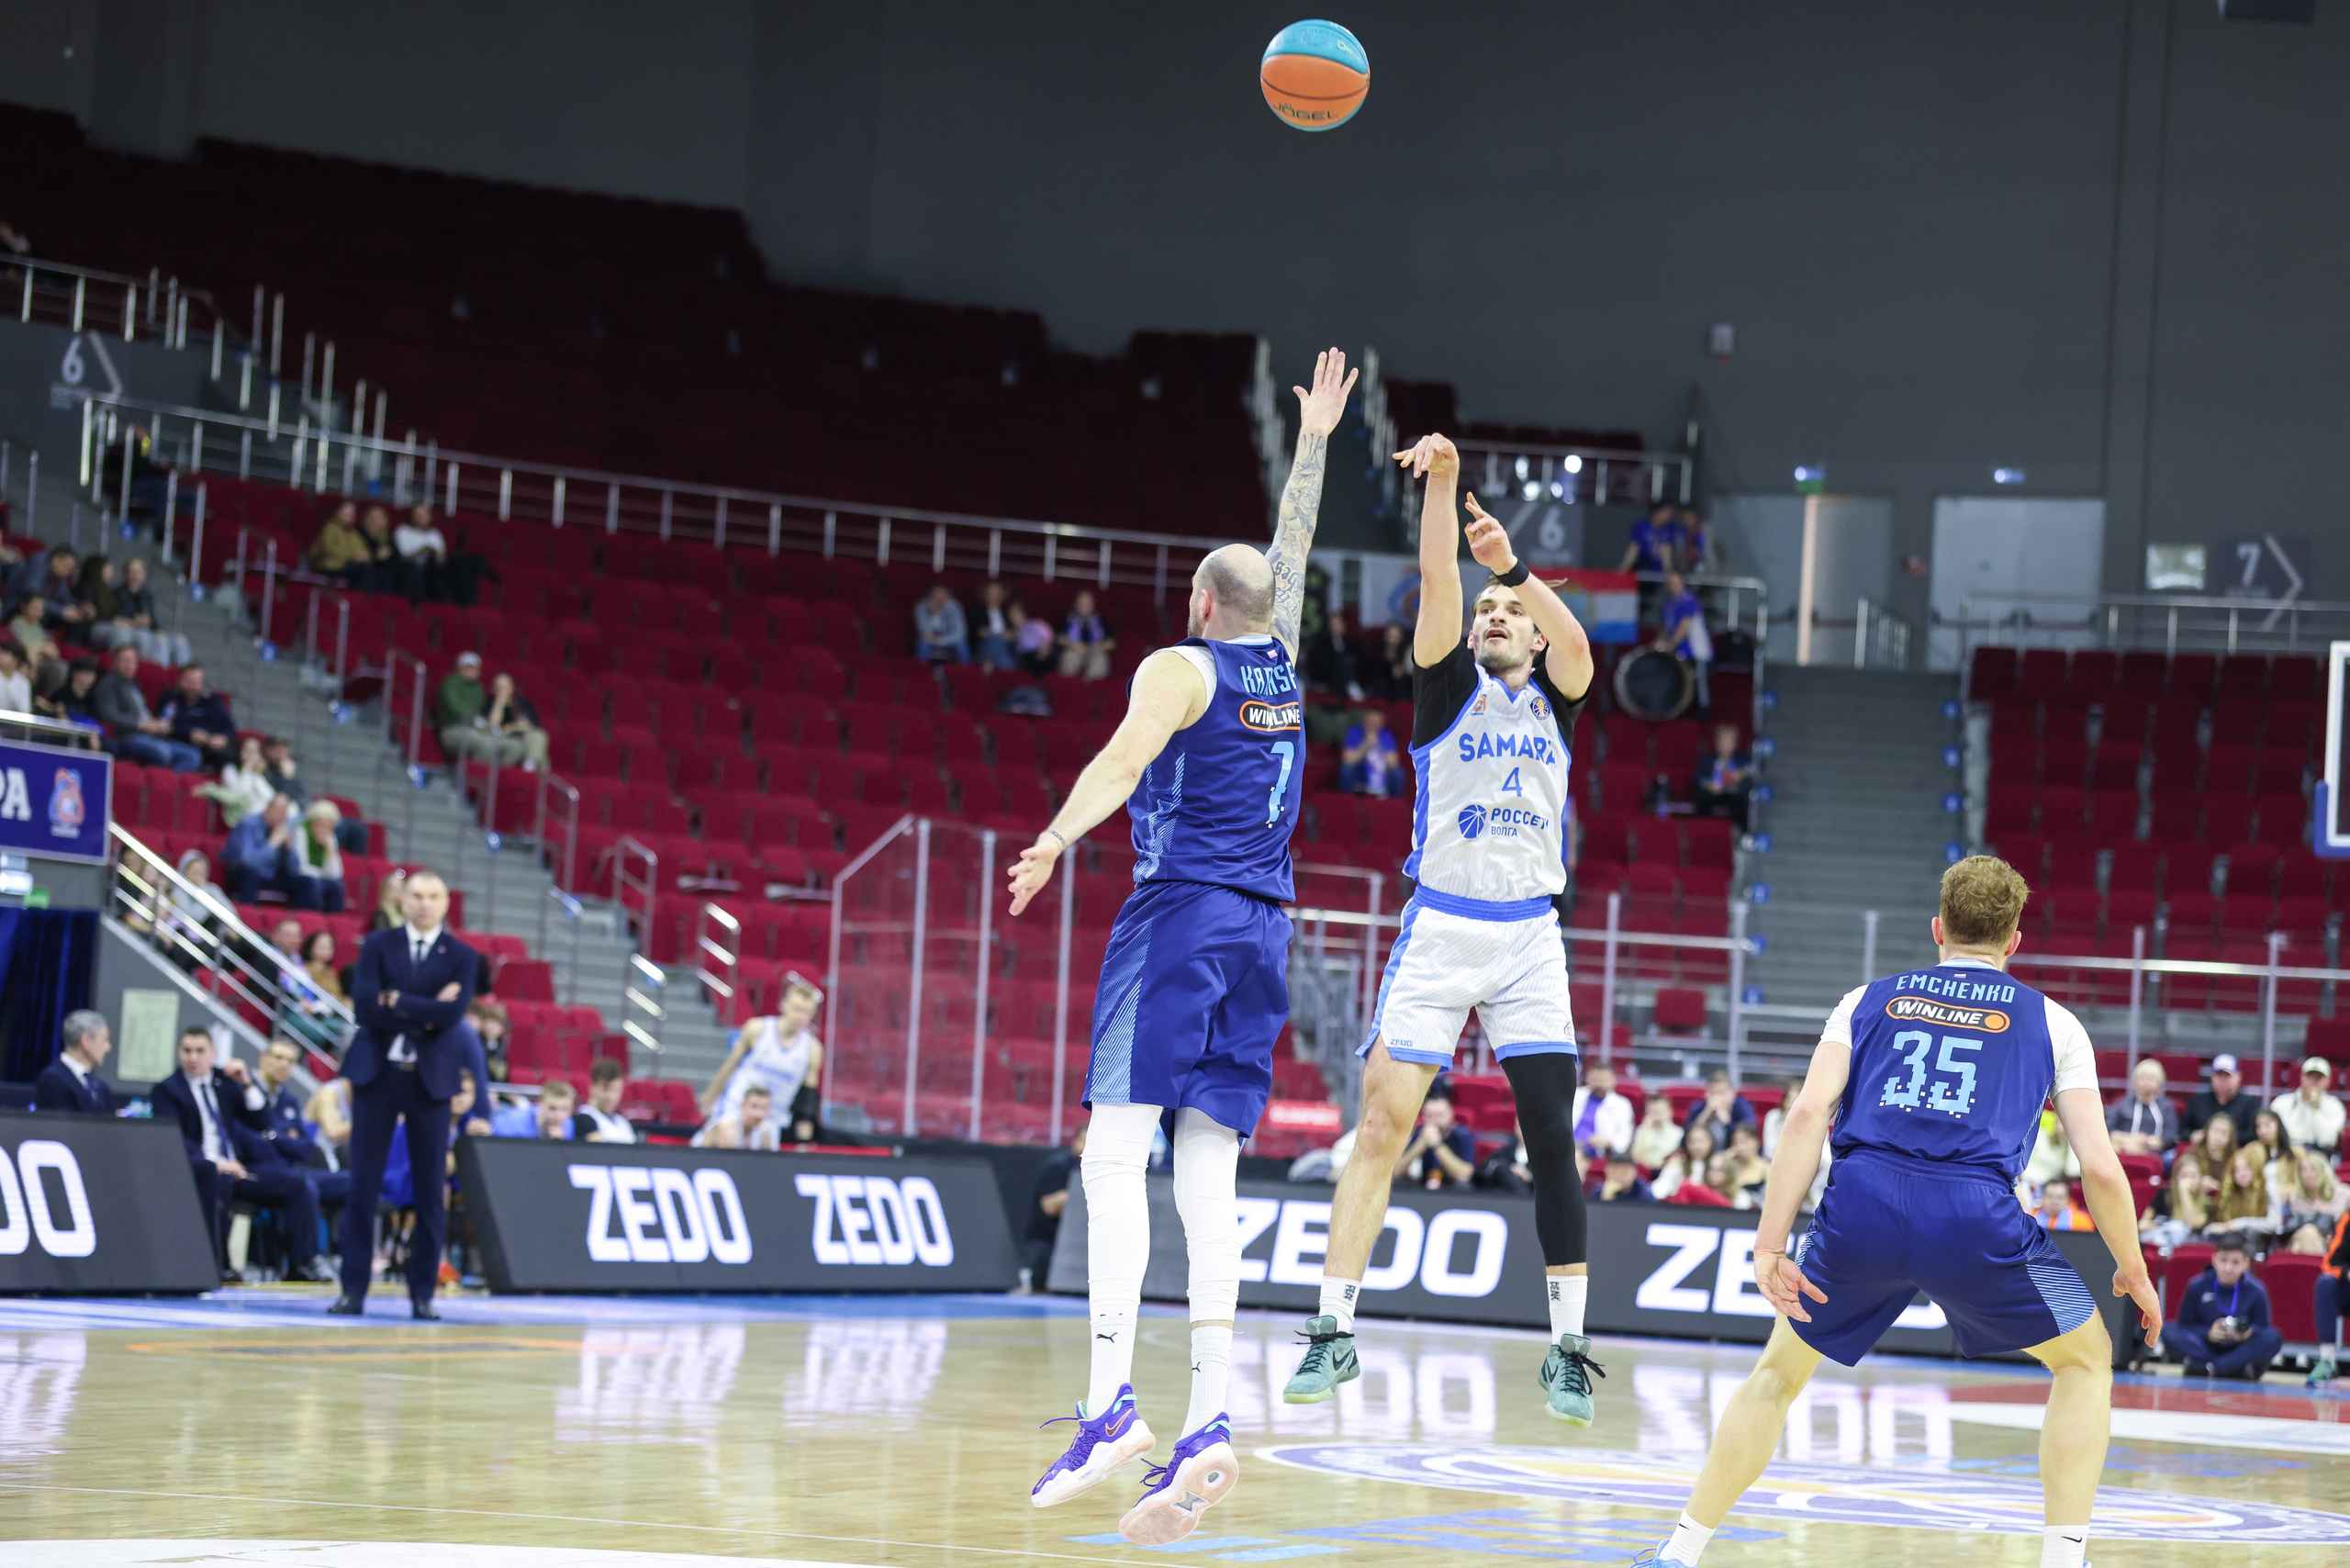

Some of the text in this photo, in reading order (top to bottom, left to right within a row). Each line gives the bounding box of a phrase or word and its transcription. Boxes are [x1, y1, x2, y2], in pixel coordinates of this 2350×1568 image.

[62, 336, 84, 386] 6
[1539, 504, 1565, 551] 6
[2237, 543, 2260, 588] 7
[1249, 707, 1301, 726] WINLINE
[1459, 732, 1557, 767] SAMARA
[1268, 741, 1295, 826] 7
[1501, 767, 1523, 797] 4
[1491, 826, 1517, 837] ВОЛГА
[1896, 974, 2016, 1003] EMCHENKO
[1897, 1001, 1984, 1025] WINLINE
[1880, 1030, 1984, 1116] 35
[568, 1164, 954, 1267] ZEDO ZEDO
